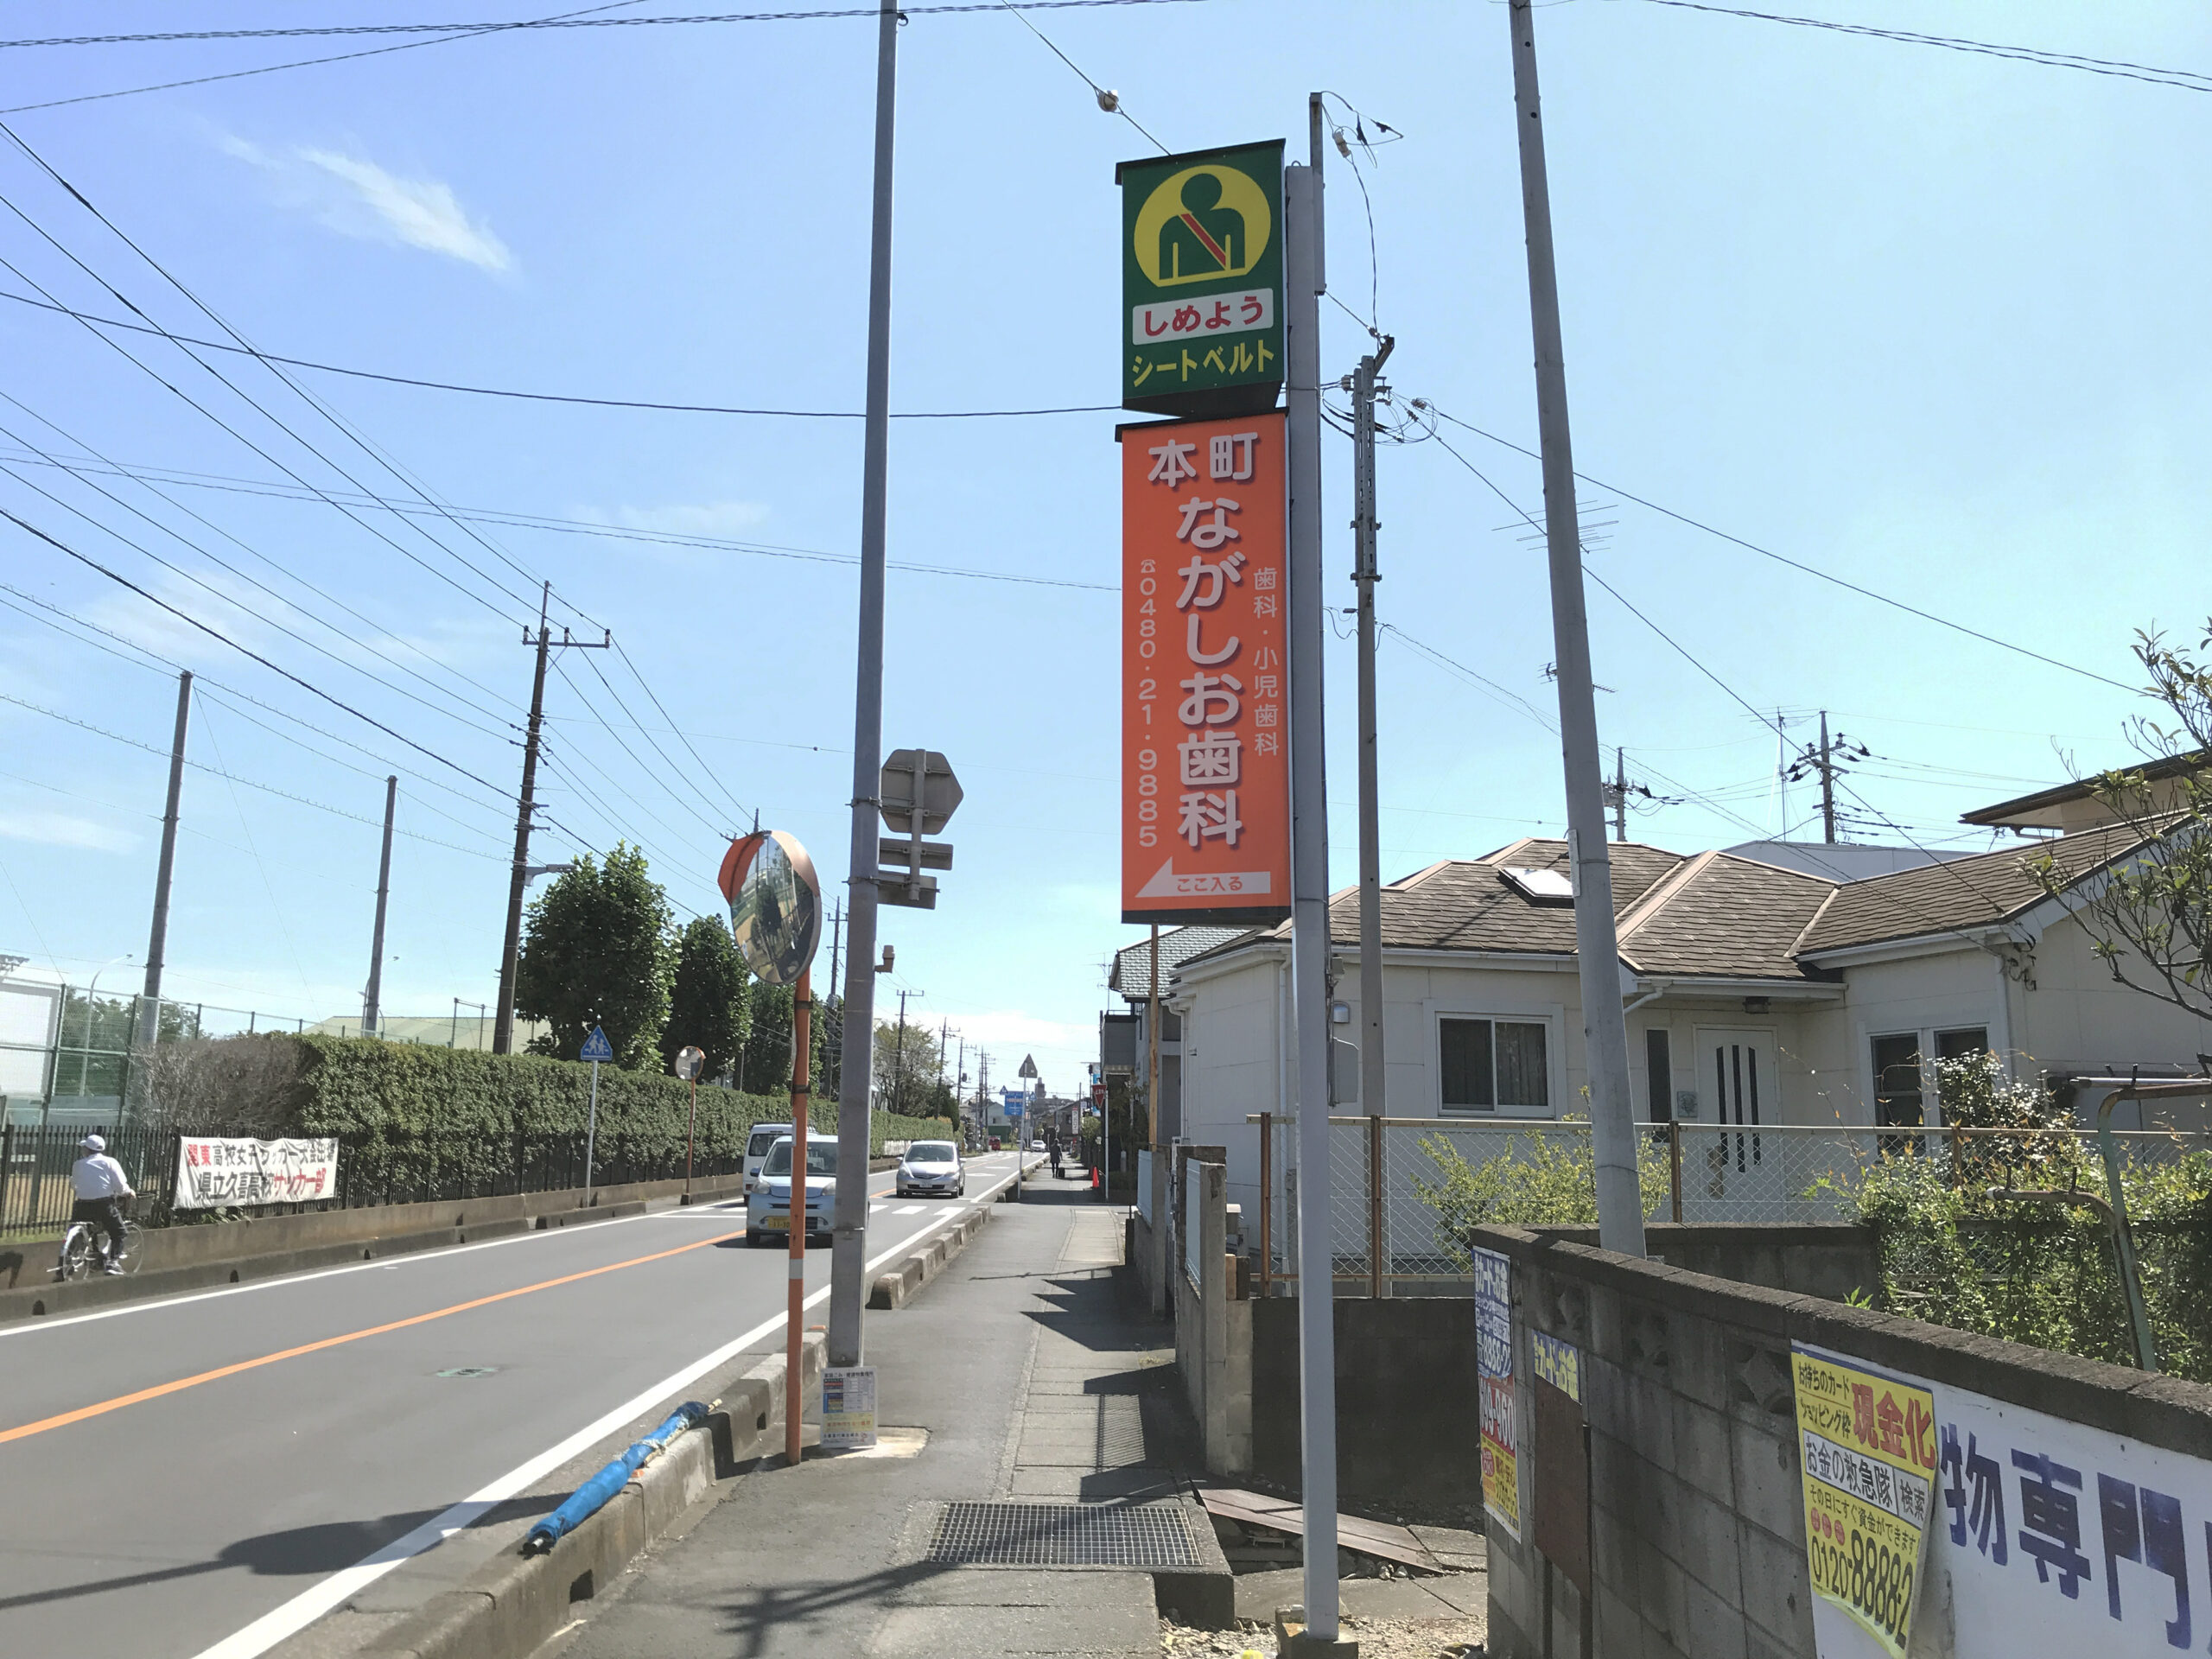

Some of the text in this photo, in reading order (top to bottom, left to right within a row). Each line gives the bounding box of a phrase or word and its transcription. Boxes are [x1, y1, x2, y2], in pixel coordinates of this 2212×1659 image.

[1145, 296, 1263, 337] しめよう
[1132, 339, 1274, 387] シートベルト
[1147, 432, 1258, 487] 本町
[1176, 496, 1246, 848] ながしお歯科
[1253, 566, 1279, 757] 歯科・小児歯科
[1176, 875, 1243, 893] ここ入る
[1798, 1361, 1850, 1401] お持ちのカード
[1800, 1396, 1852, 1440] ショッピング枠
[1851, 1382, 1936, 1470] 現金化
[1806, 1435, 1893, 1509] お金の救急隊
[1900, 1478, 1925, 1522] 検索
[1941, 1422, 2212, 1656] 物専門
